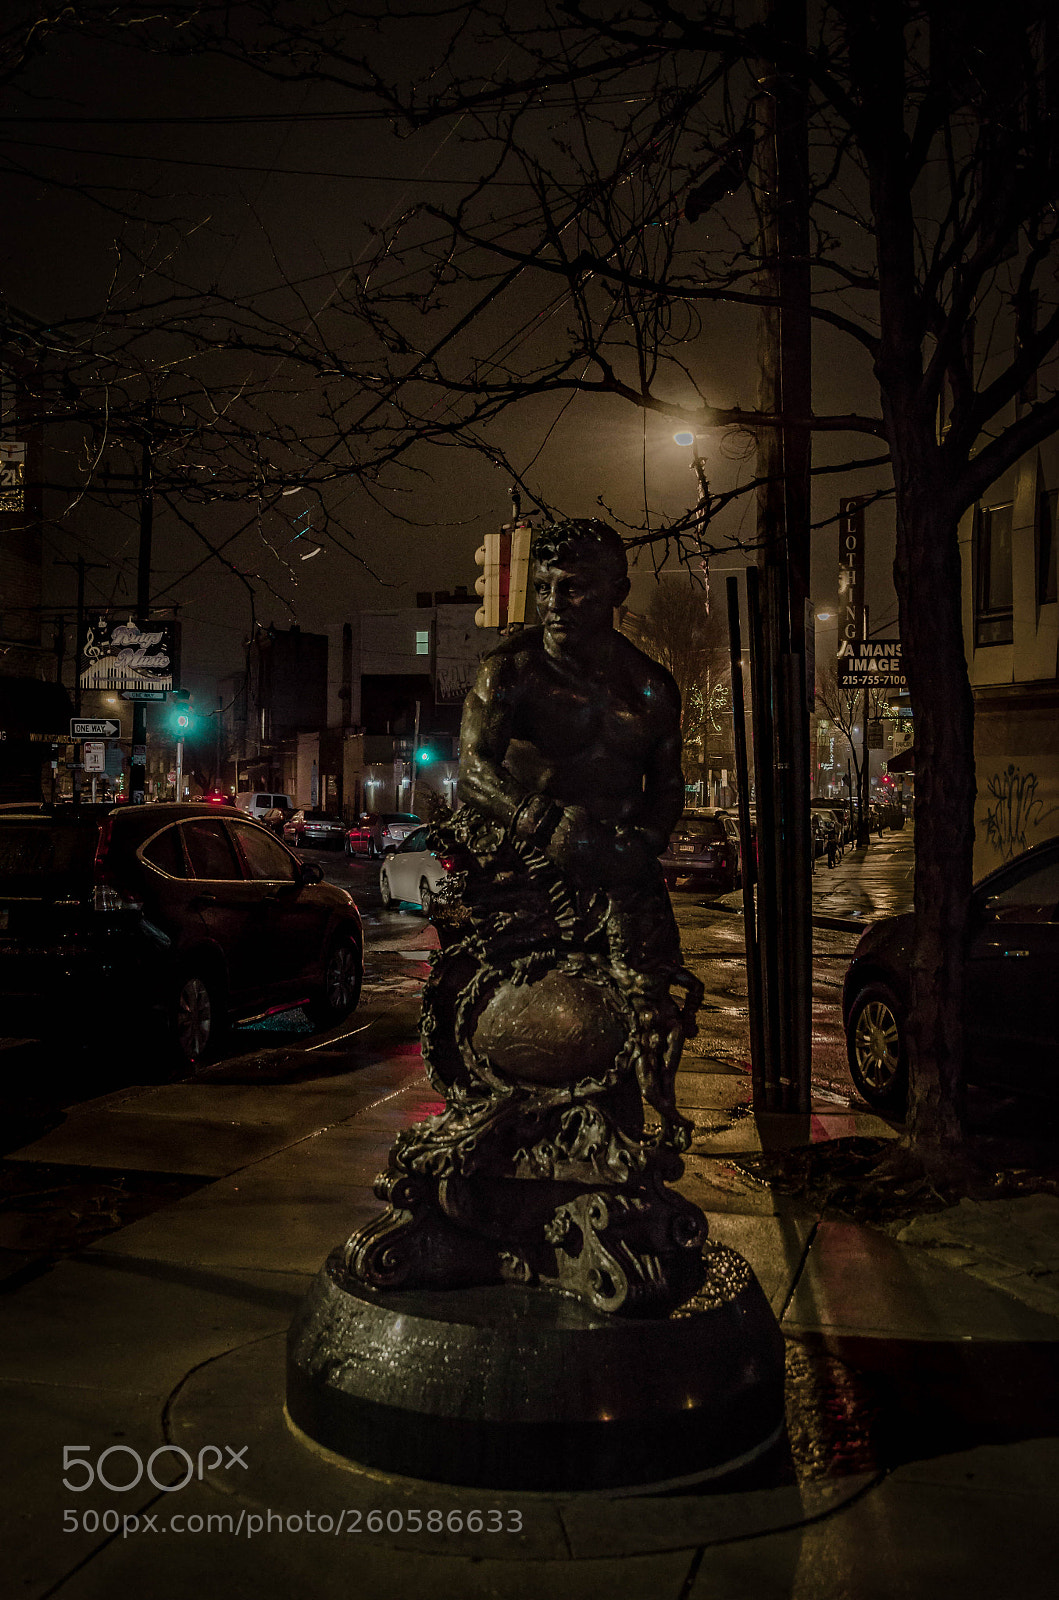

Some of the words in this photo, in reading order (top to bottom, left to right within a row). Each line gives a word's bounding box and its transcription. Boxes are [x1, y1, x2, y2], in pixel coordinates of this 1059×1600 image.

[844, 501, 857, 639] CLOTHING
[843, 643, 855, 657] A
[113, 647, 170, 669] Music
[848, 658, 900, 672] IMAGE
[842, 675, 907, 686] 215-755-7100
[76, 724, 90, 733] ONE
[91, 724, 106, 733] WAY
